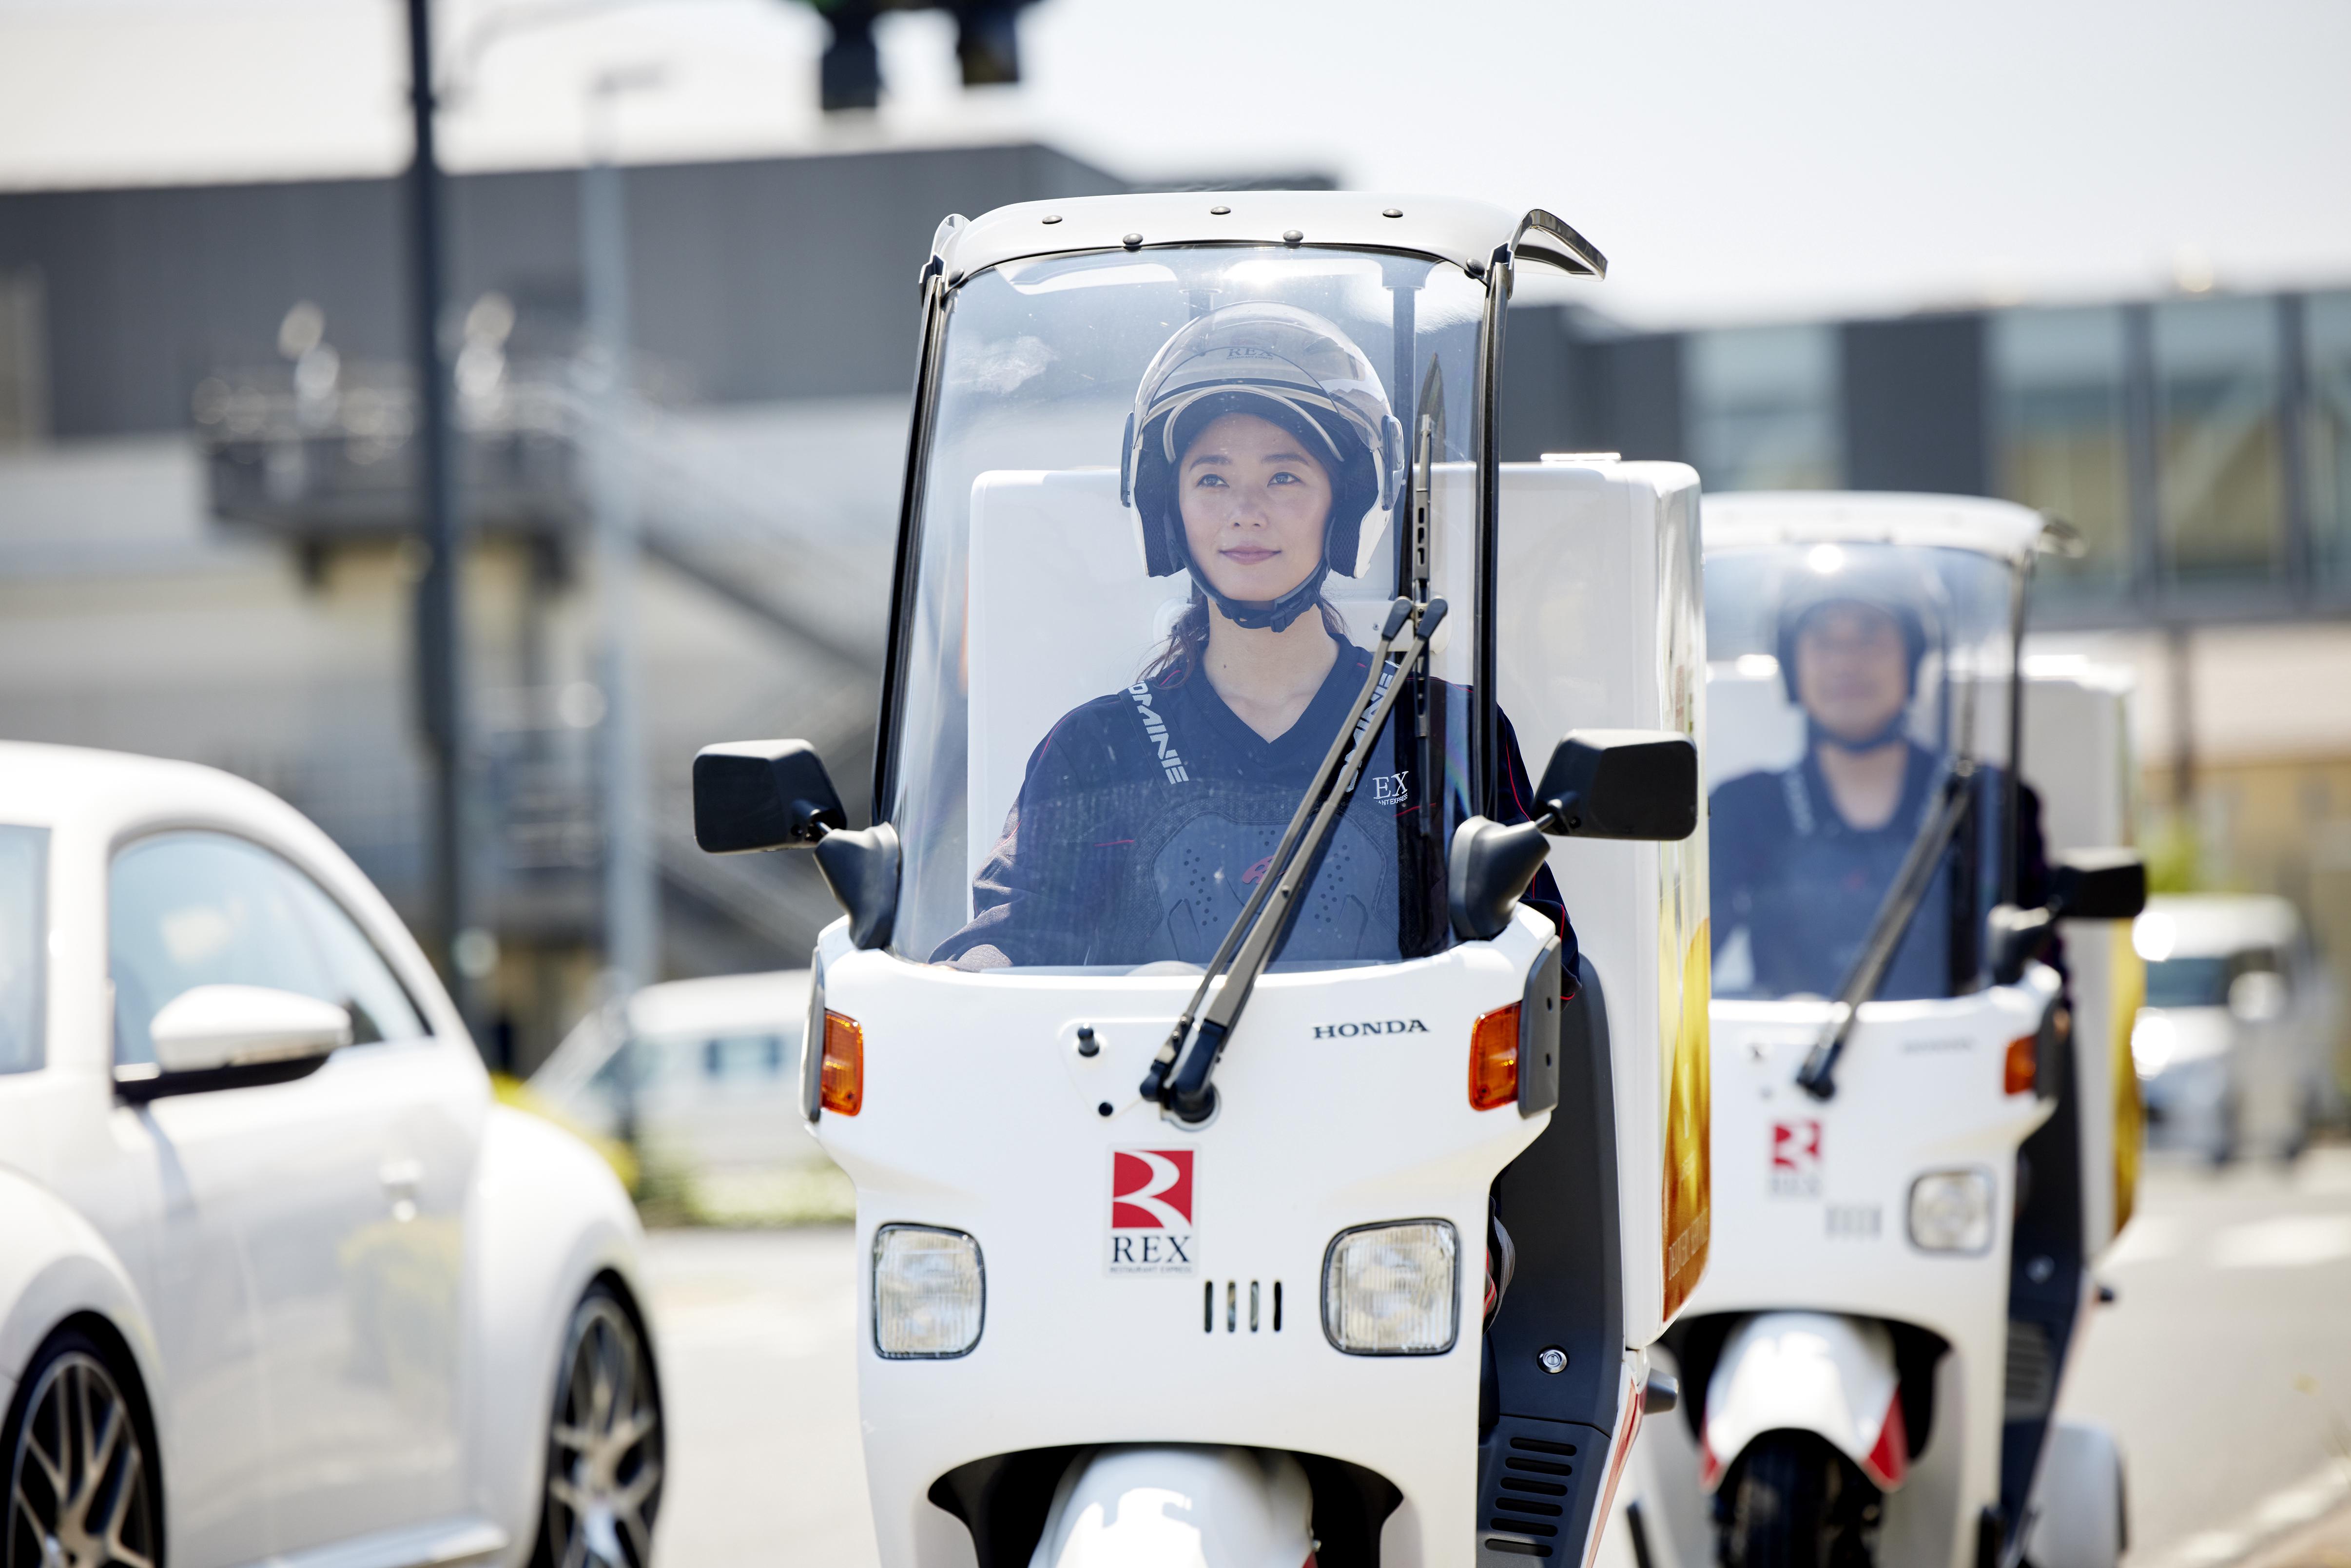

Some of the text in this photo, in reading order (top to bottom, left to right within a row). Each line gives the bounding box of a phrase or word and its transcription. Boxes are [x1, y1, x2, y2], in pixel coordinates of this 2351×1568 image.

[1372, 771, 1409, 799] EX
[1313, 1019, 1429, 1039] HONDA
[1112, 1235, 1190, 1263] REX
